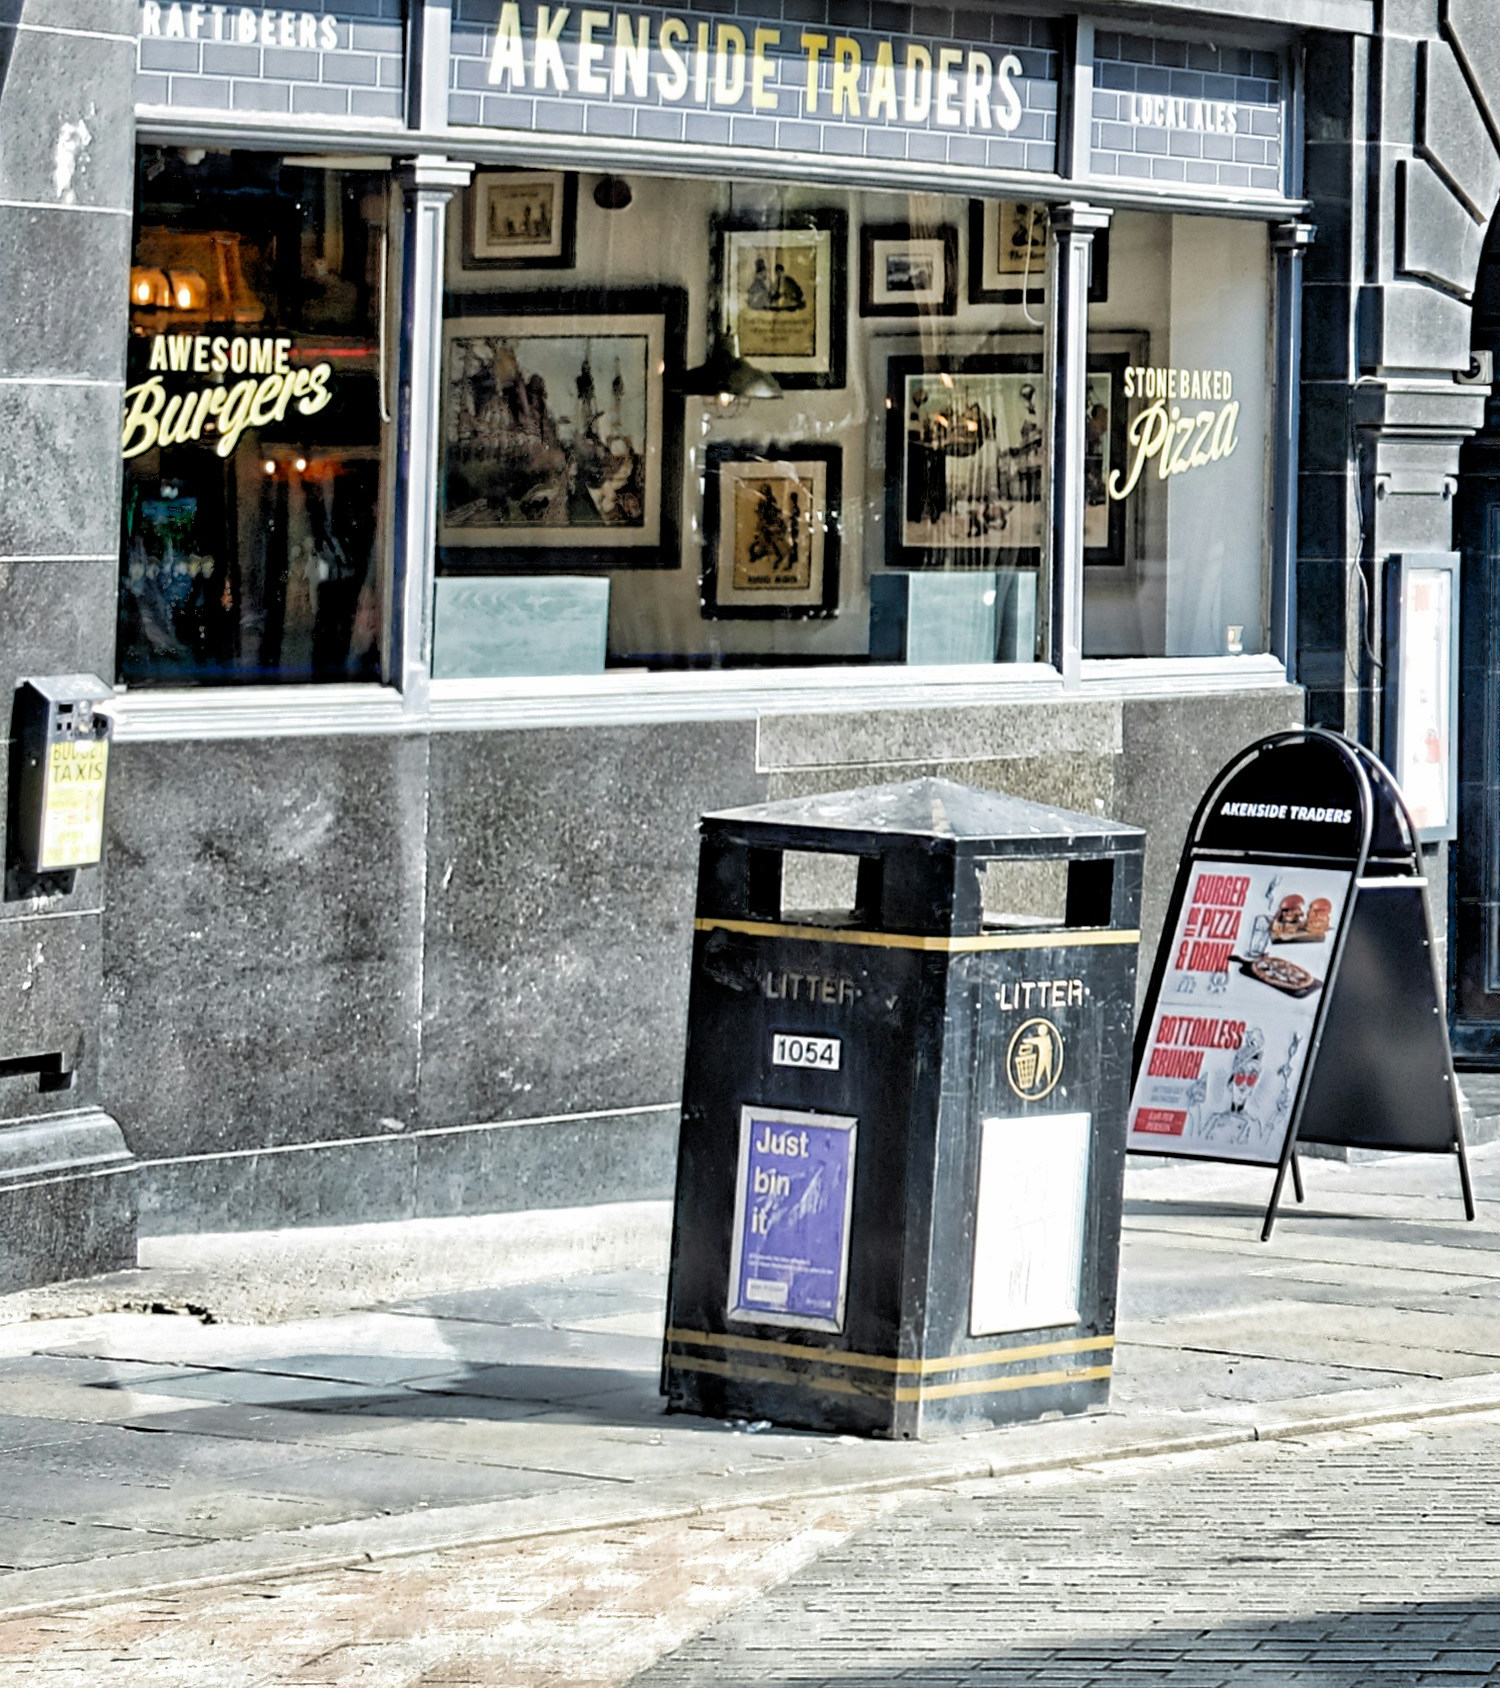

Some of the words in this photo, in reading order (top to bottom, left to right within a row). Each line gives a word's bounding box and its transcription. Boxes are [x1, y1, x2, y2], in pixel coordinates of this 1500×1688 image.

[239, 7, 338, 50] BEERS
[487, 1, 780, 111] AKENSIDE
[800, 31, 1025, 133] TRADERS
[1130, 94, 1188, 129] LOCAL
[1193, 101, 1238, 134] ALES
[149, 336, 291, 374] AWESOME
[1123, 365, 1176, 399] STONE
[1180, 369, 1233, 401] BAKED
[121, 361, 333, 459] Burgers
[1108, 397, 1240, 502] Pizza
[53, 761, 103, 783] TAXIS
[1221, 801, 1288, 819] AKENSIDE
[1290, 805, 1352, 824] TRADERS
[1192, 873, 1251, 907] BURGER
[1198, 907, 1242, 940] PIZZA
[1175, 939, 1189, 971] &
[1187, 940, 1235, 974] DRINK
[765, 971, 855, 1006] LITTER
[1000, 978, 1083, 1011] LITTER
[1155, 1015, 1247, 1051] BOTTOMLESS
[776, 1038, 835, 1065] 1054
[1147, 1047, 1205, 1080] BRUNCH
[756, 1126, 810, 1158] Just
[754, 1165, 791, 1197] bin
[751, 1206, 768, 1236] it
